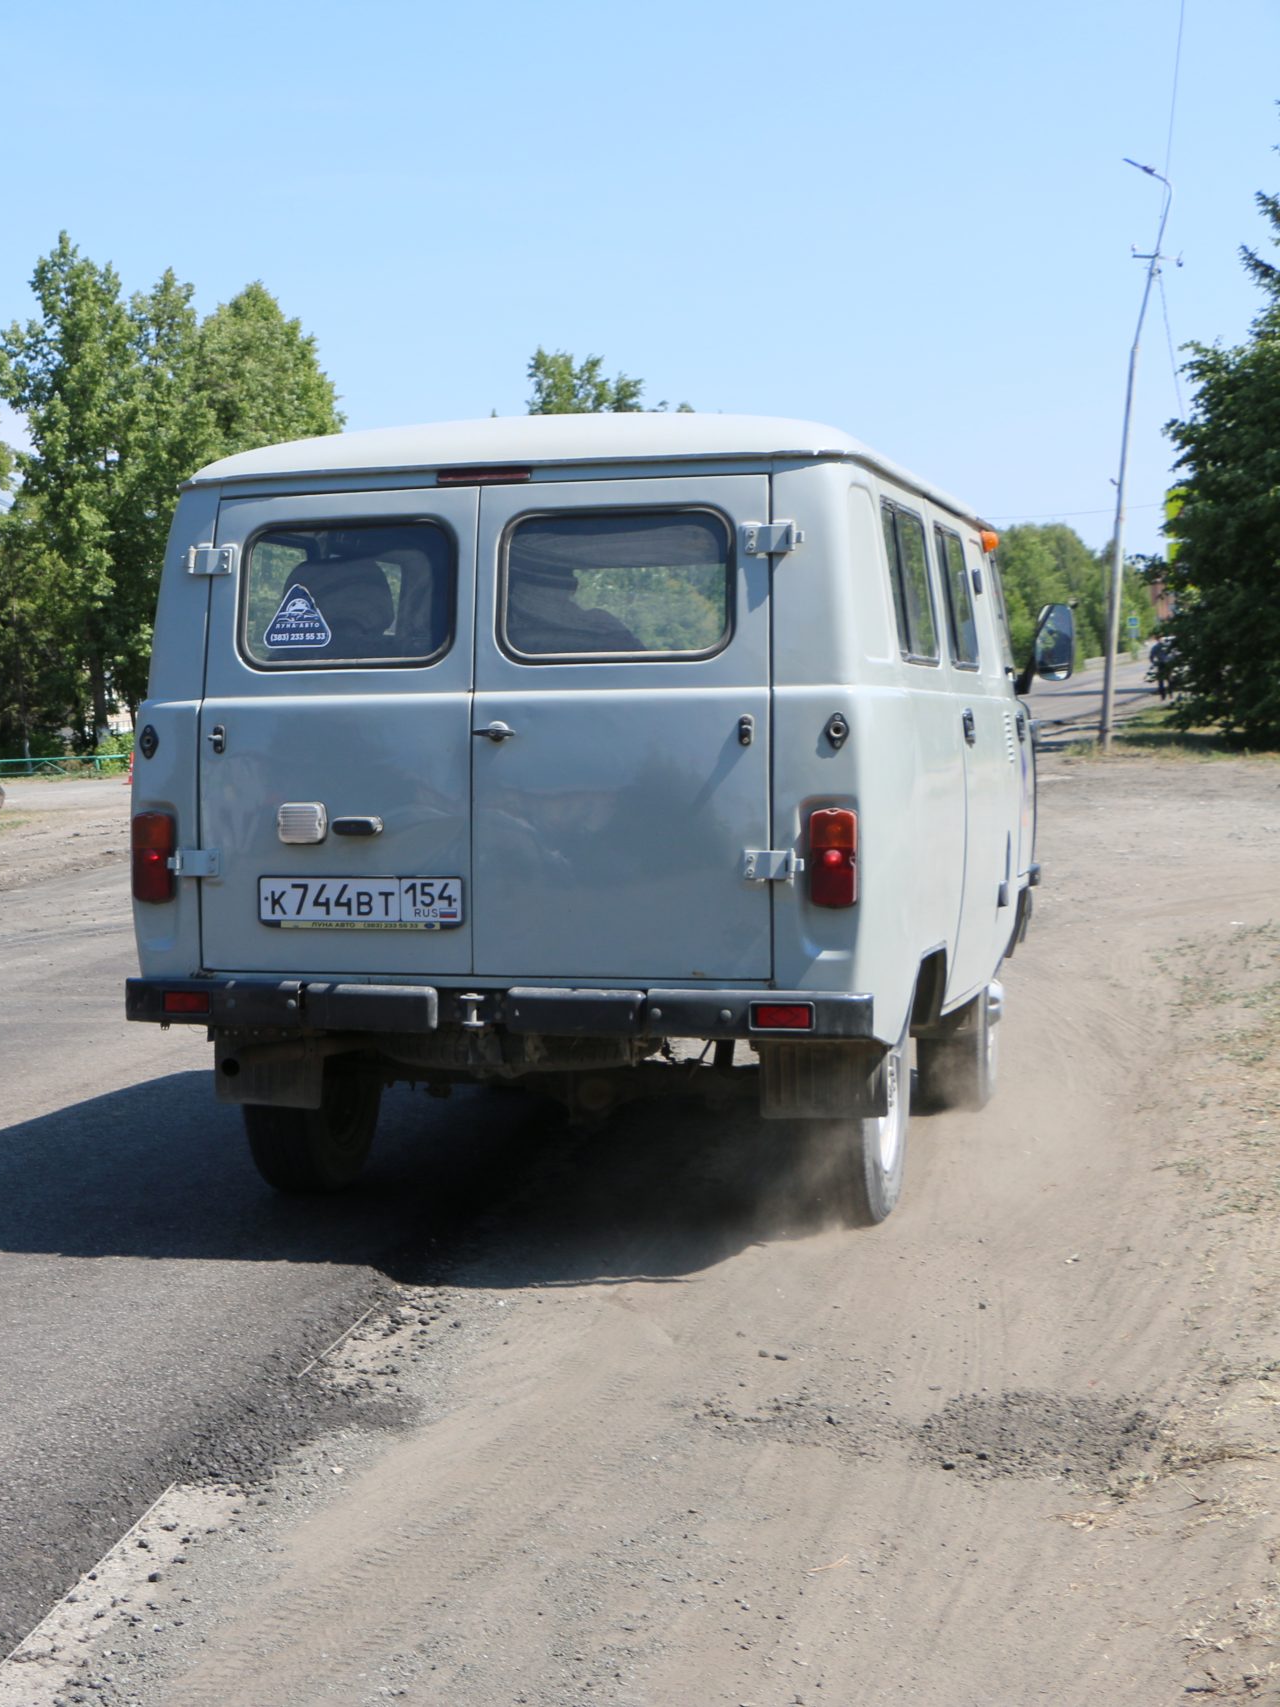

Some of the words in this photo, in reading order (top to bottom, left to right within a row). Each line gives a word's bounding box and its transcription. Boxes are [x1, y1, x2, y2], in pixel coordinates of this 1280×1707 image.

[270, 883, 395, 916] К744ВТ
[404, 882, 453, 908] 154
[414, 908, 438, 918] RUS
